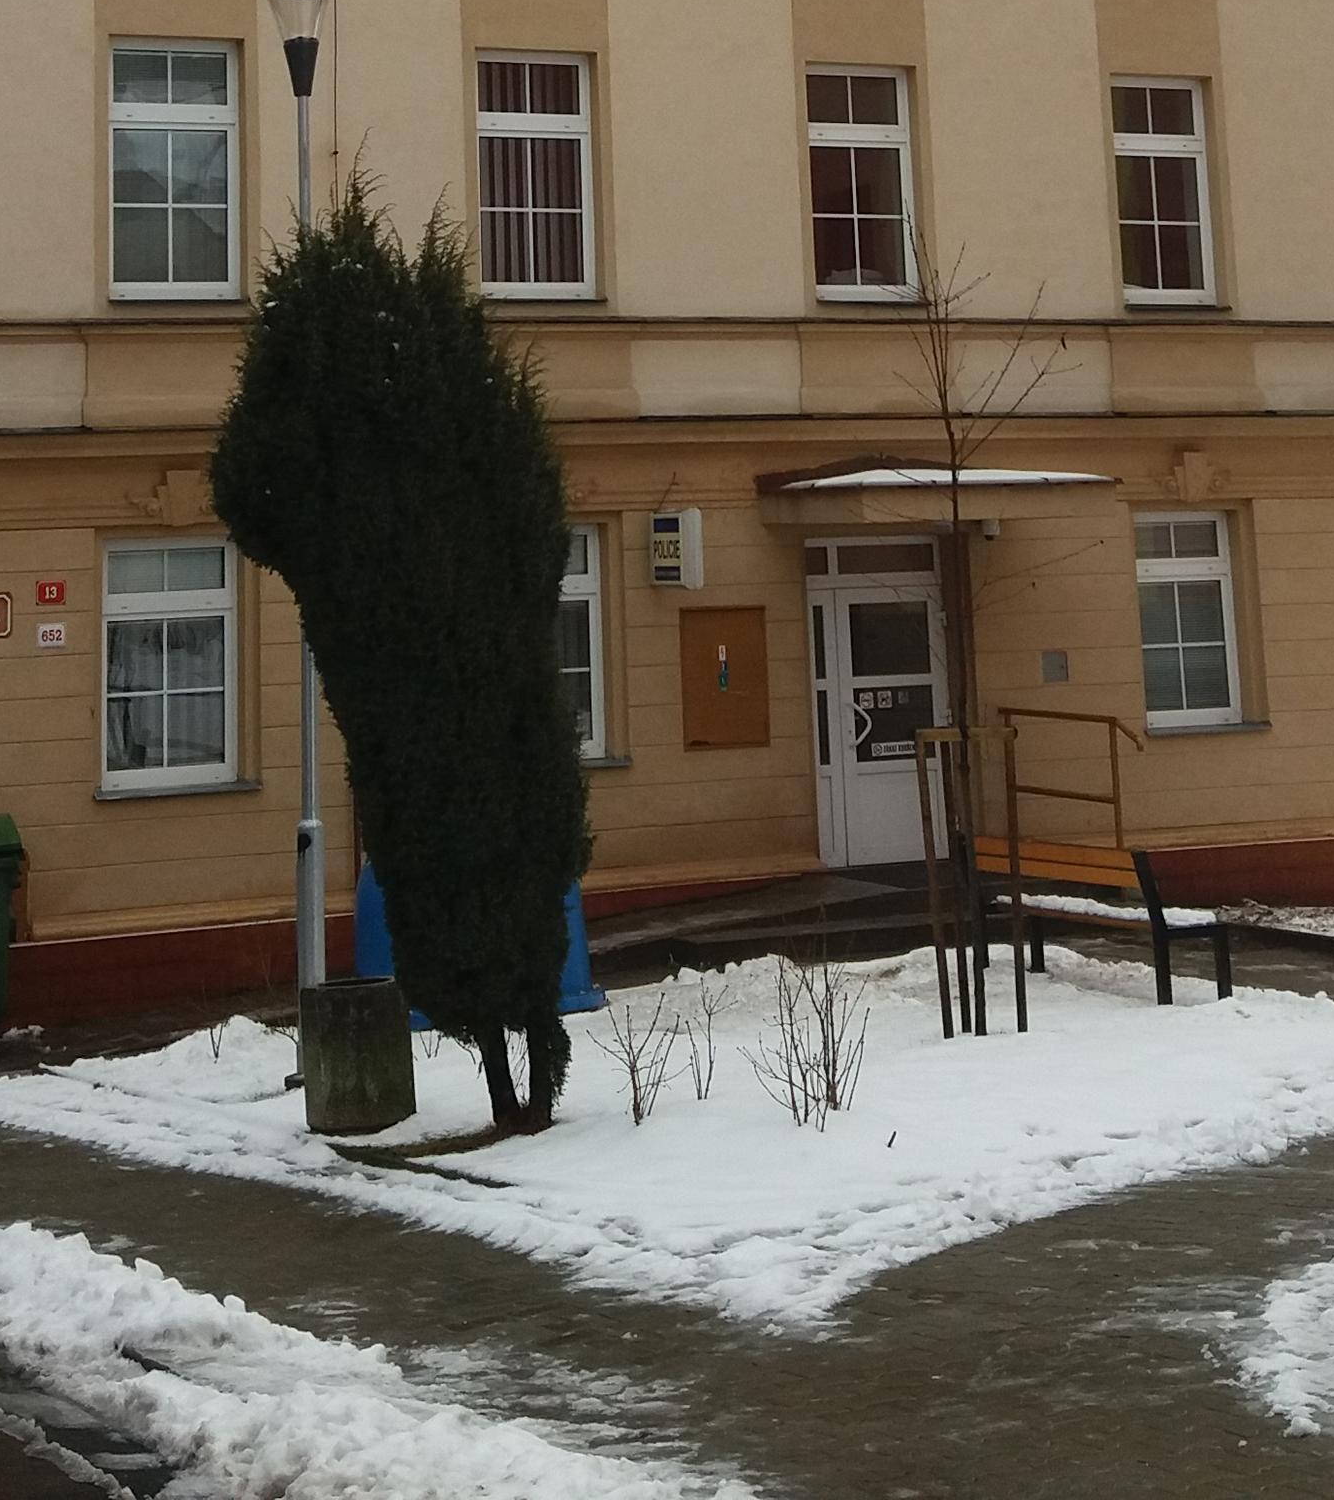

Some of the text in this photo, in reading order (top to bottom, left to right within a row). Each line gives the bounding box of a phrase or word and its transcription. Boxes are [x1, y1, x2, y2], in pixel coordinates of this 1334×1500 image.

[653, 540, 680, 559] POLICIE
[44, 586, 58, 600] 13
[41, 629, 63, 642] 652
